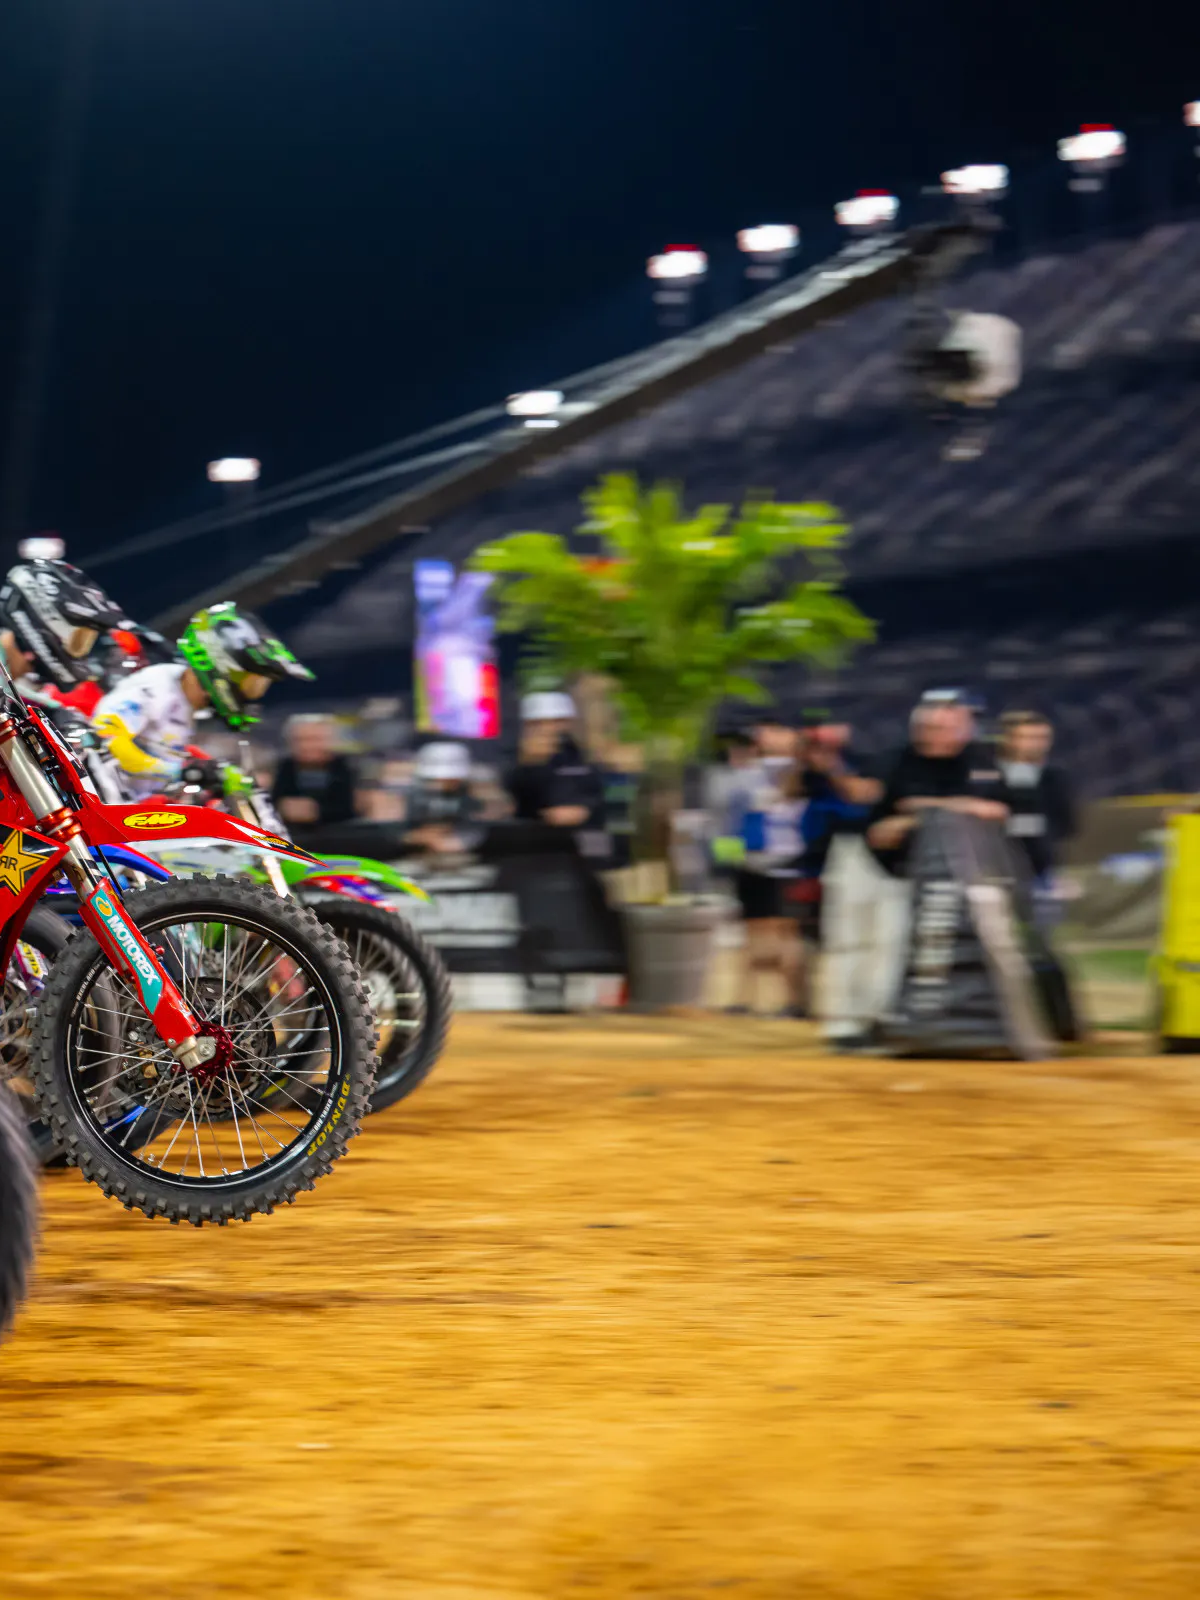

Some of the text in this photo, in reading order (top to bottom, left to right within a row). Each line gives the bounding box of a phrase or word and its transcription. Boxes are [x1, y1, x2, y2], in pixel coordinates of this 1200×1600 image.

[125, 812, 186, 828] FMF
[106, 914, 161, 986] MOTOREX
[307, 1080, 350, 1157] DUNLOP
